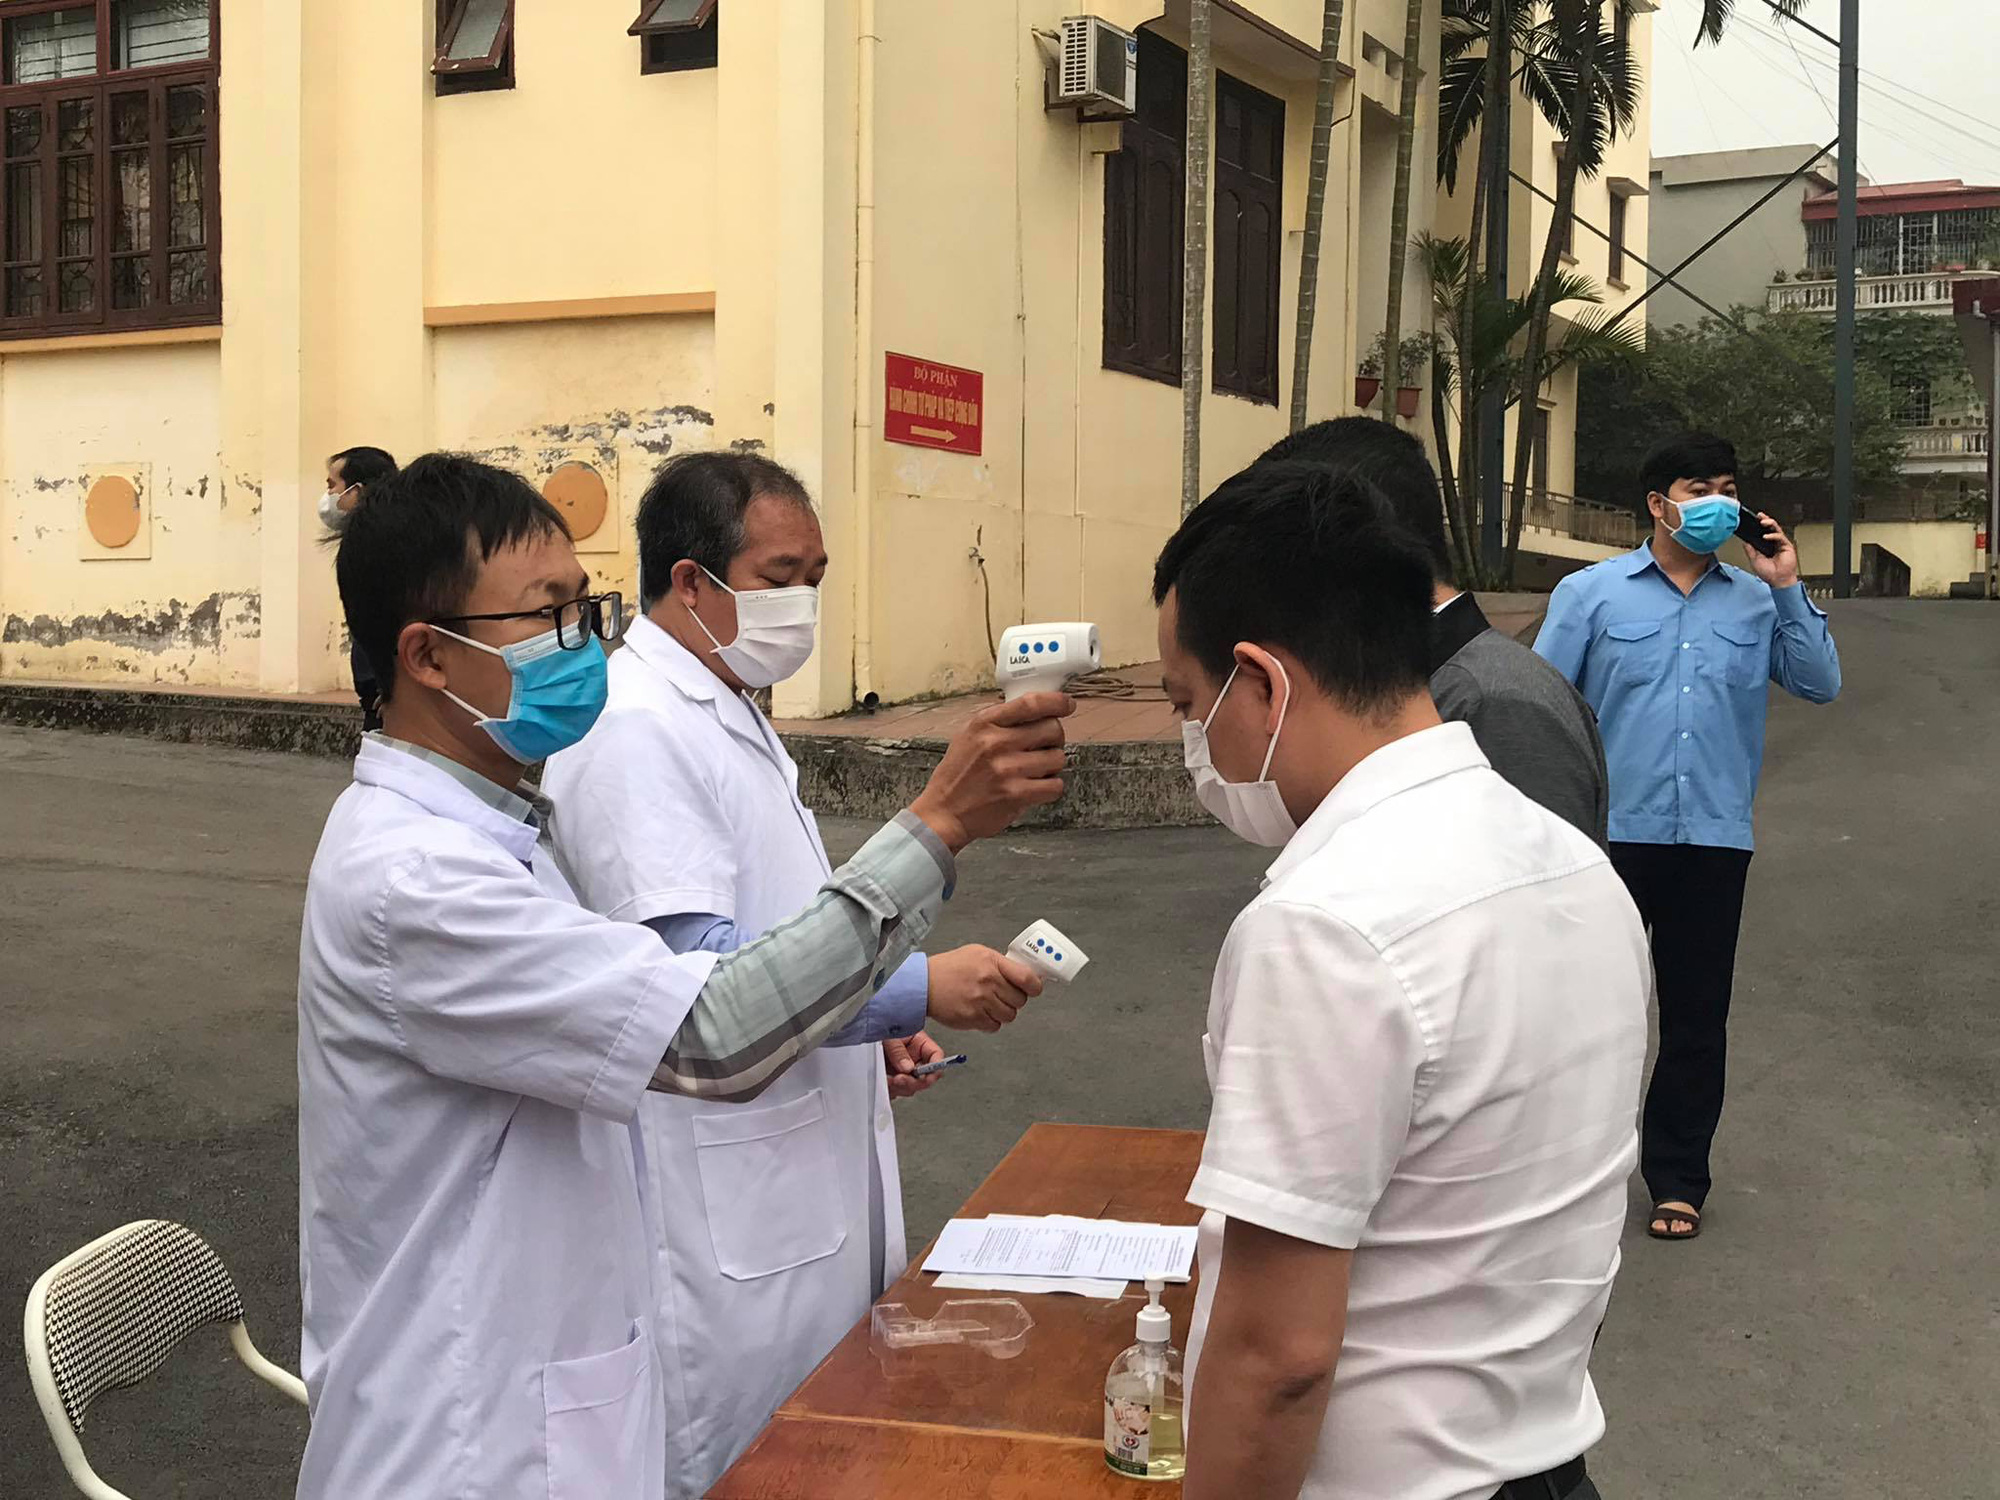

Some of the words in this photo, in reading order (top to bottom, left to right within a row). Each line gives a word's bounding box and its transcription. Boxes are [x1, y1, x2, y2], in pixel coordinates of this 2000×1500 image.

[914, 365, 928, 383] BỘ
[930, 369, 958, 388] PHẬN
[1010, 656, 1030, 665] LAICA
